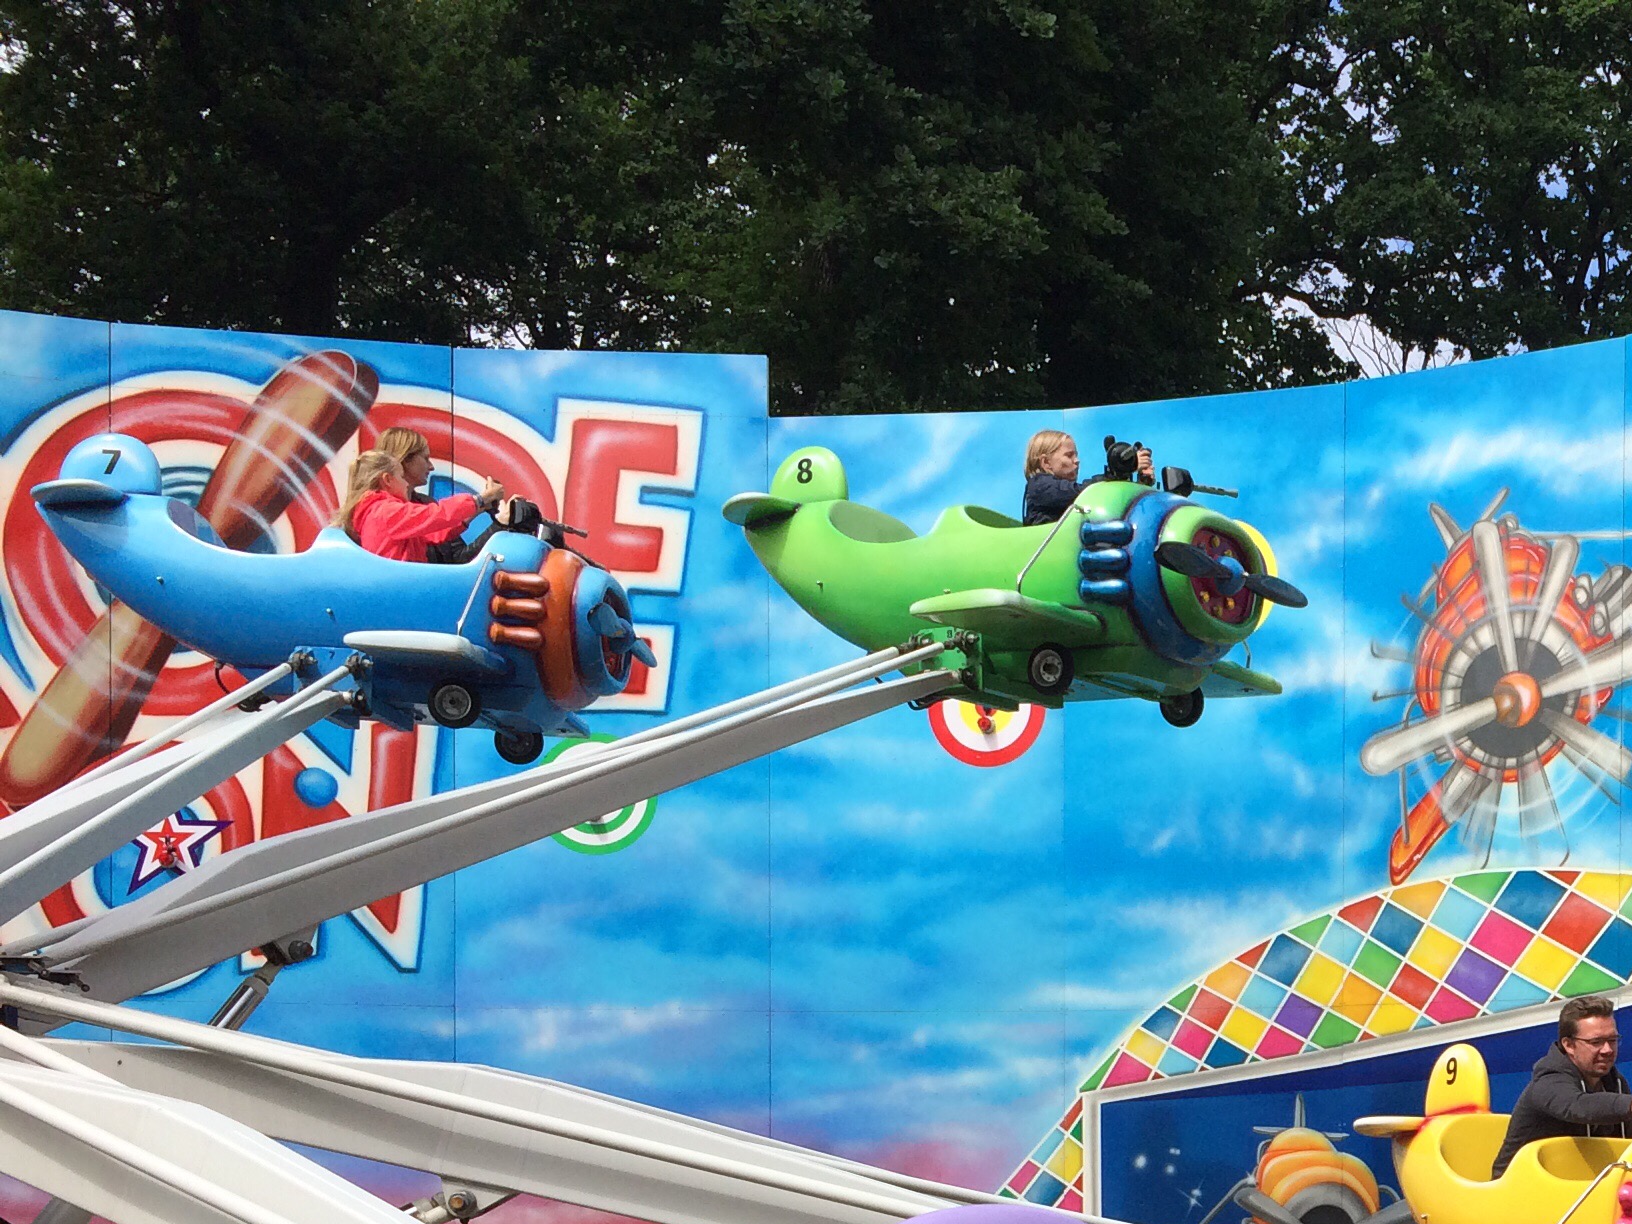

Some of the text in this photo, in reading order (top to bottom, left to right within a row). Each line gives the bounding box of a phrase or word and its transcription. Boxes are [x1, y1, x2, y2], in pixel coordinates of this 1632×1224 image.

[102, 449, 121, 475] 7
[796, 457, 813, 484] 8
[1446, 1056, 1458, 1085] 9
